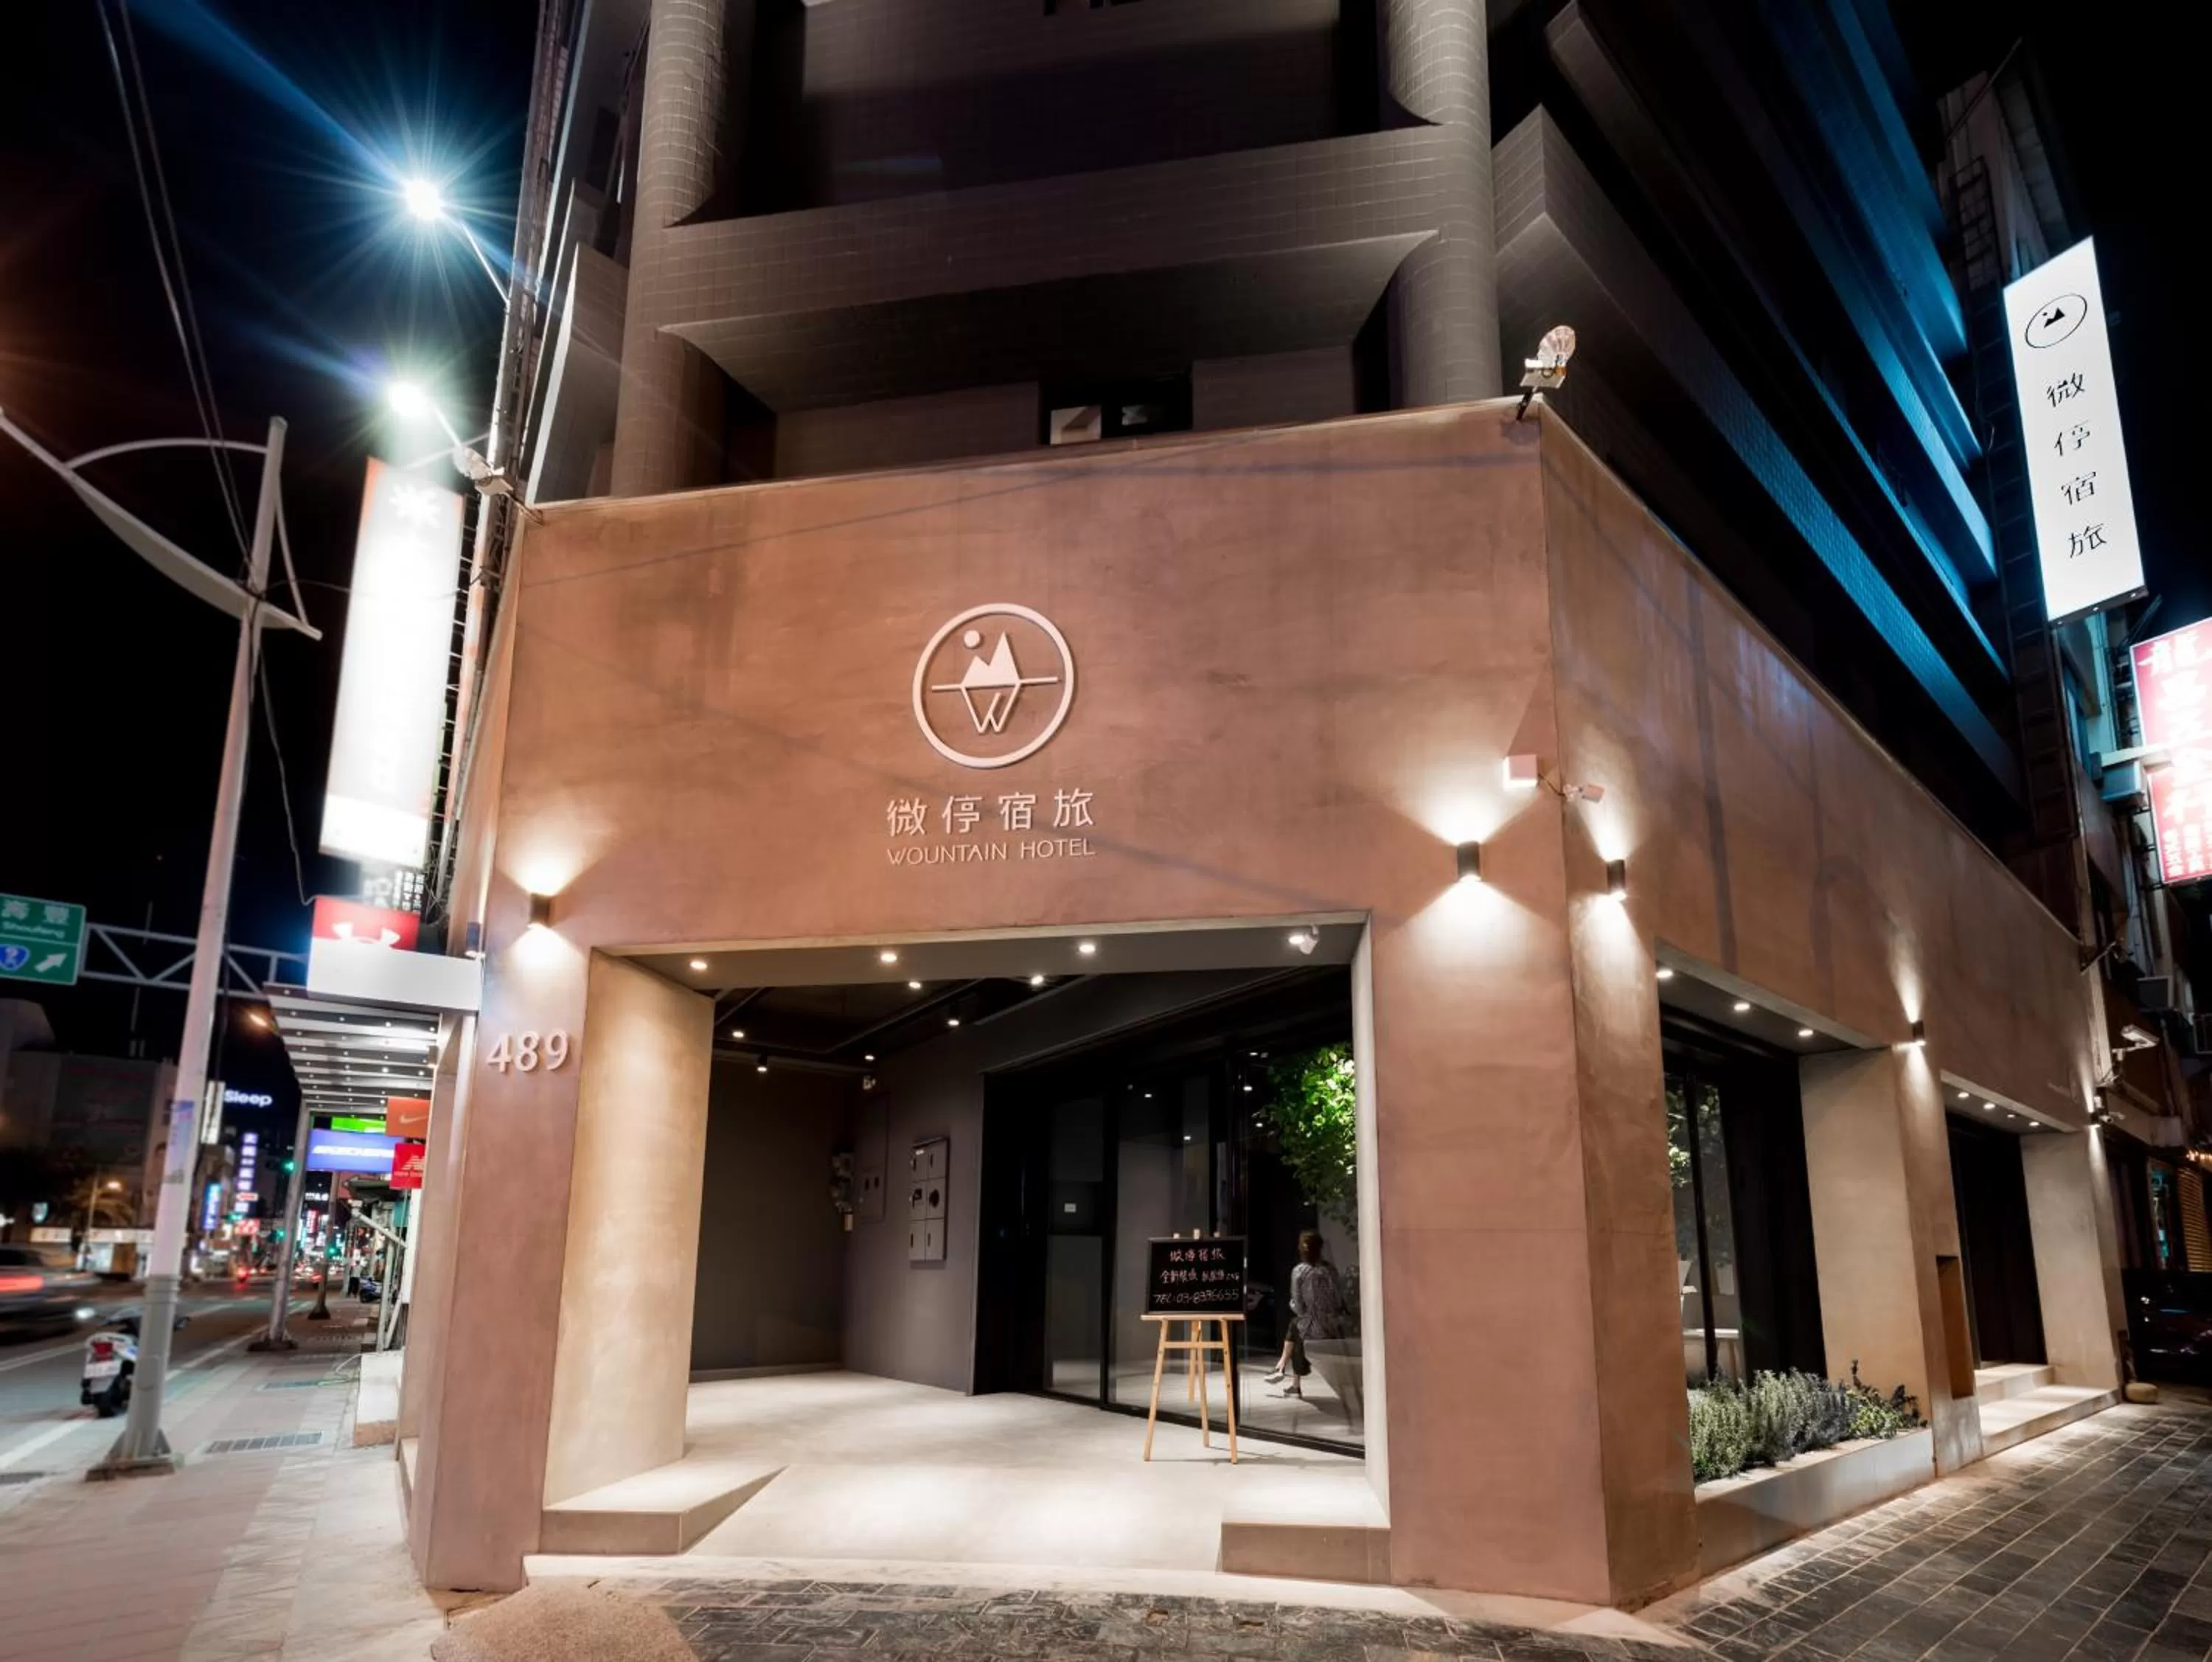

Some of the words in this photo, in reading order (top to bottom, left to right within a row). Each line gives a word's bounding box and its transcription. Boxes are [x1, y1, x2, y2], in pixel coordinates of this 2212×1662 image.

[2046, 372, 2107, 559] 微停宿旅
[886, 787, 1095, 837] 微停宿旅
[887, 841, 1008, 866] WOUNTAIN
[1020, 838, 1096, 860] HOTEL
[485, 1028, 569, 1074] 489
[223, 1089, 272, 1107] Sleep
